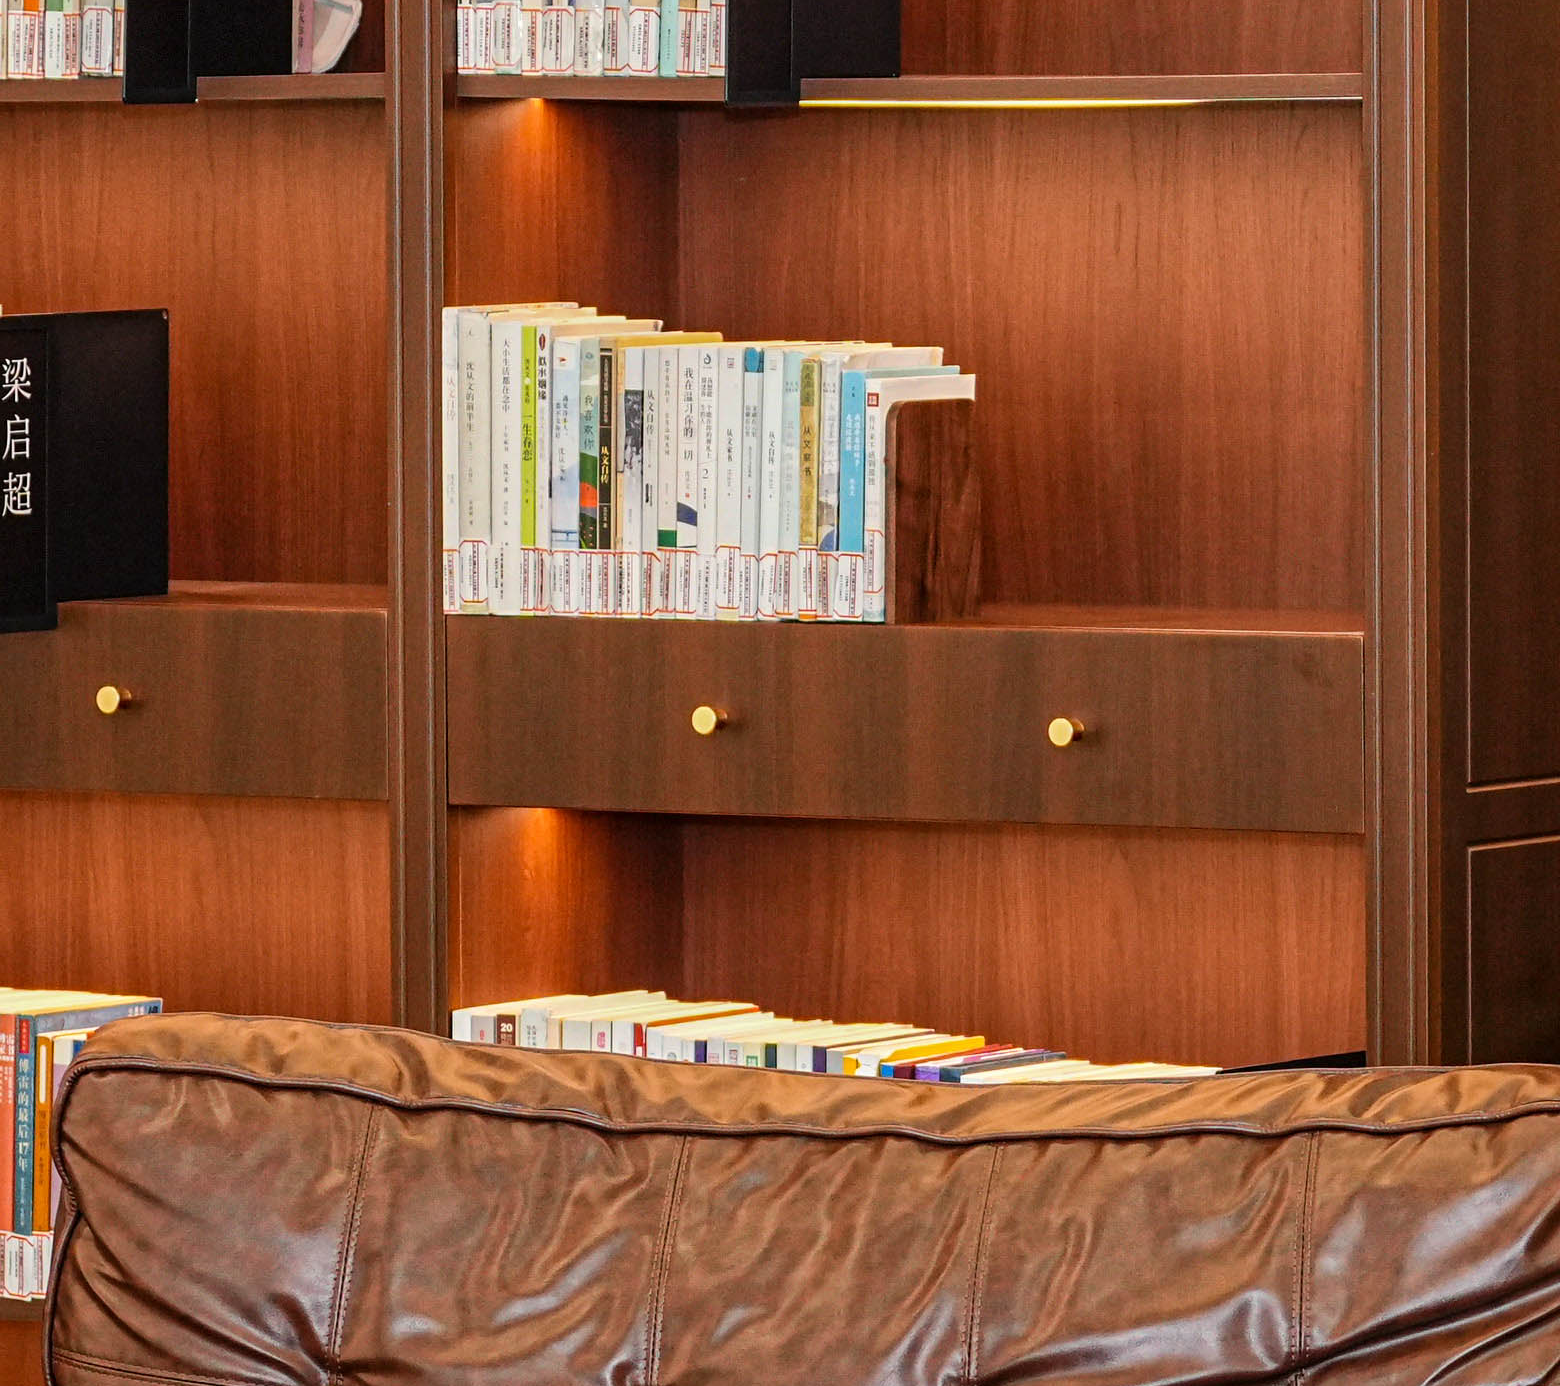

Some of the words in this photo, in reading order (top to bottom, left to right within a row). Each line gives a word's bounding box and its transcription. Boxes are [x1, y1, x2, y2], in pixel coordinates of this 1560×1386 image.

[0, 356, 33, 517] 梁启超
[583, 394, 595, 451] 我喜欢你
[645, 389, 655, 436] 从文自传
[682, 366, 694, 462] 我在温习你的一切
[600, 445, 610, 485] 从文自传
[802, 425, 813, 477] 从文家书
[500, 1022, 514, 1032] 20
[17, 1057, 30, 1173] 傅雷的最后17年
